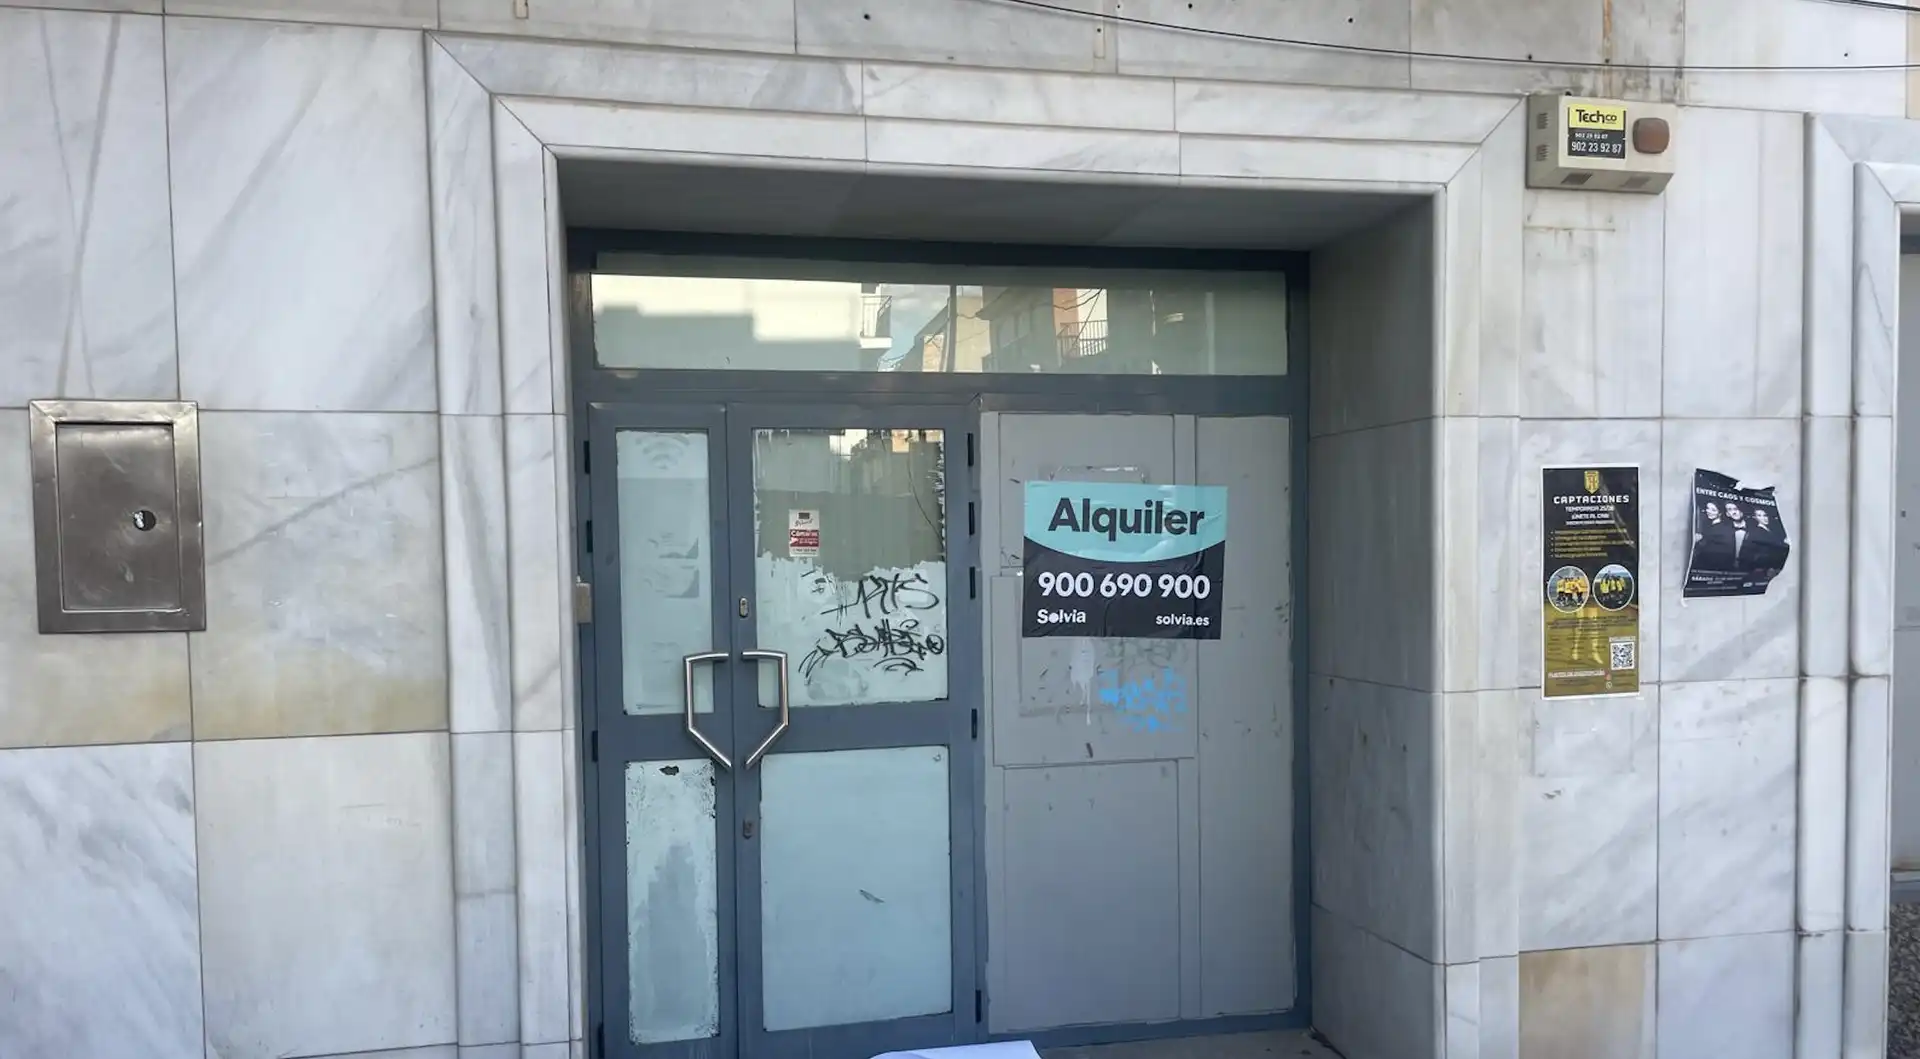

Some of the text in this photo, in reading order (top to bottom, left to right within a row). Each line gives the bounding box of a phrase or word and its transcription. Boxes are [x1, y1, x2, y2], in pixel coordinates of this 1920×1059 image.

[1571, 142, 1622, 154] 902 23 92 87
[1553, 495, 1630, 504] CAPTACIONES
[1696, 487, 1717, 496] ENTRE
[1717, 491, 1738, 500] CAOS
[1744, 496, 1776, 507] COSMOS
[1048, 497, 1204, 542] Alquiler
[1038, 572, 1210, 599] 900 690 900
[1037, 609, 1210, 626] Solvia solvia.es
